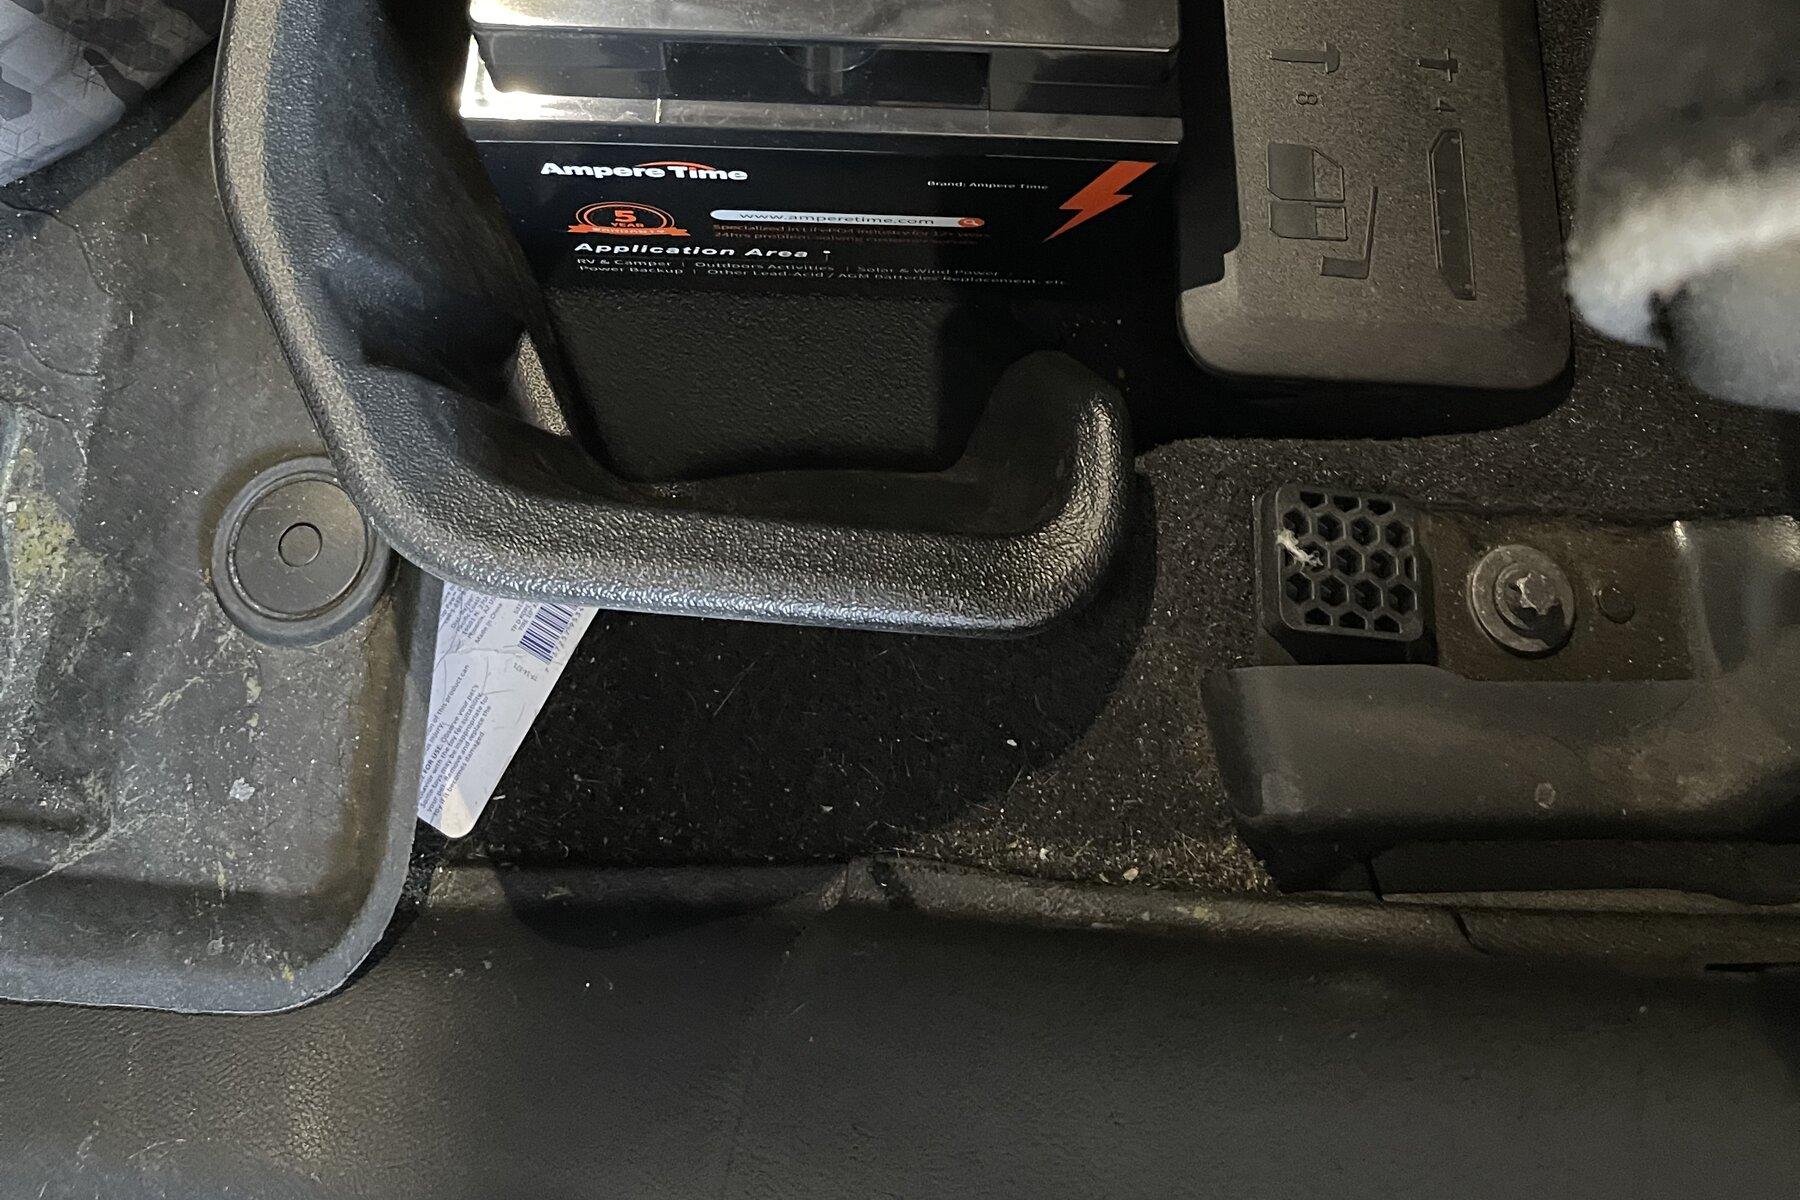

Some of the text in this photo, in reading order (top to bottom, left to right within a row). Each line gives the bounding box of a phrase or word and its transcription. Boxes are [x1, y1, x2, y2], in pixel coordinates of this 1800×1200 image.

[540, 162, 748, 181] Ampere Time
[614, 209, 637, 223] 5
[739, 213, 935, 225] www.amperetime.com
[574, 243, 808, 258] Application Area
[614, 259, 672, 268] Camper
[630, 267, 684, 275] Backup
[475, 625, 487, 644] Made
[445, 676, 464, 703] product
[441, 715, 459, 743] Observe
[455, 705, 483, 750] inappropriate
[444, 754, 462, 781] Remove
[468, 716, 485, 741] replace
[447, 761, 467, 792] becomes
